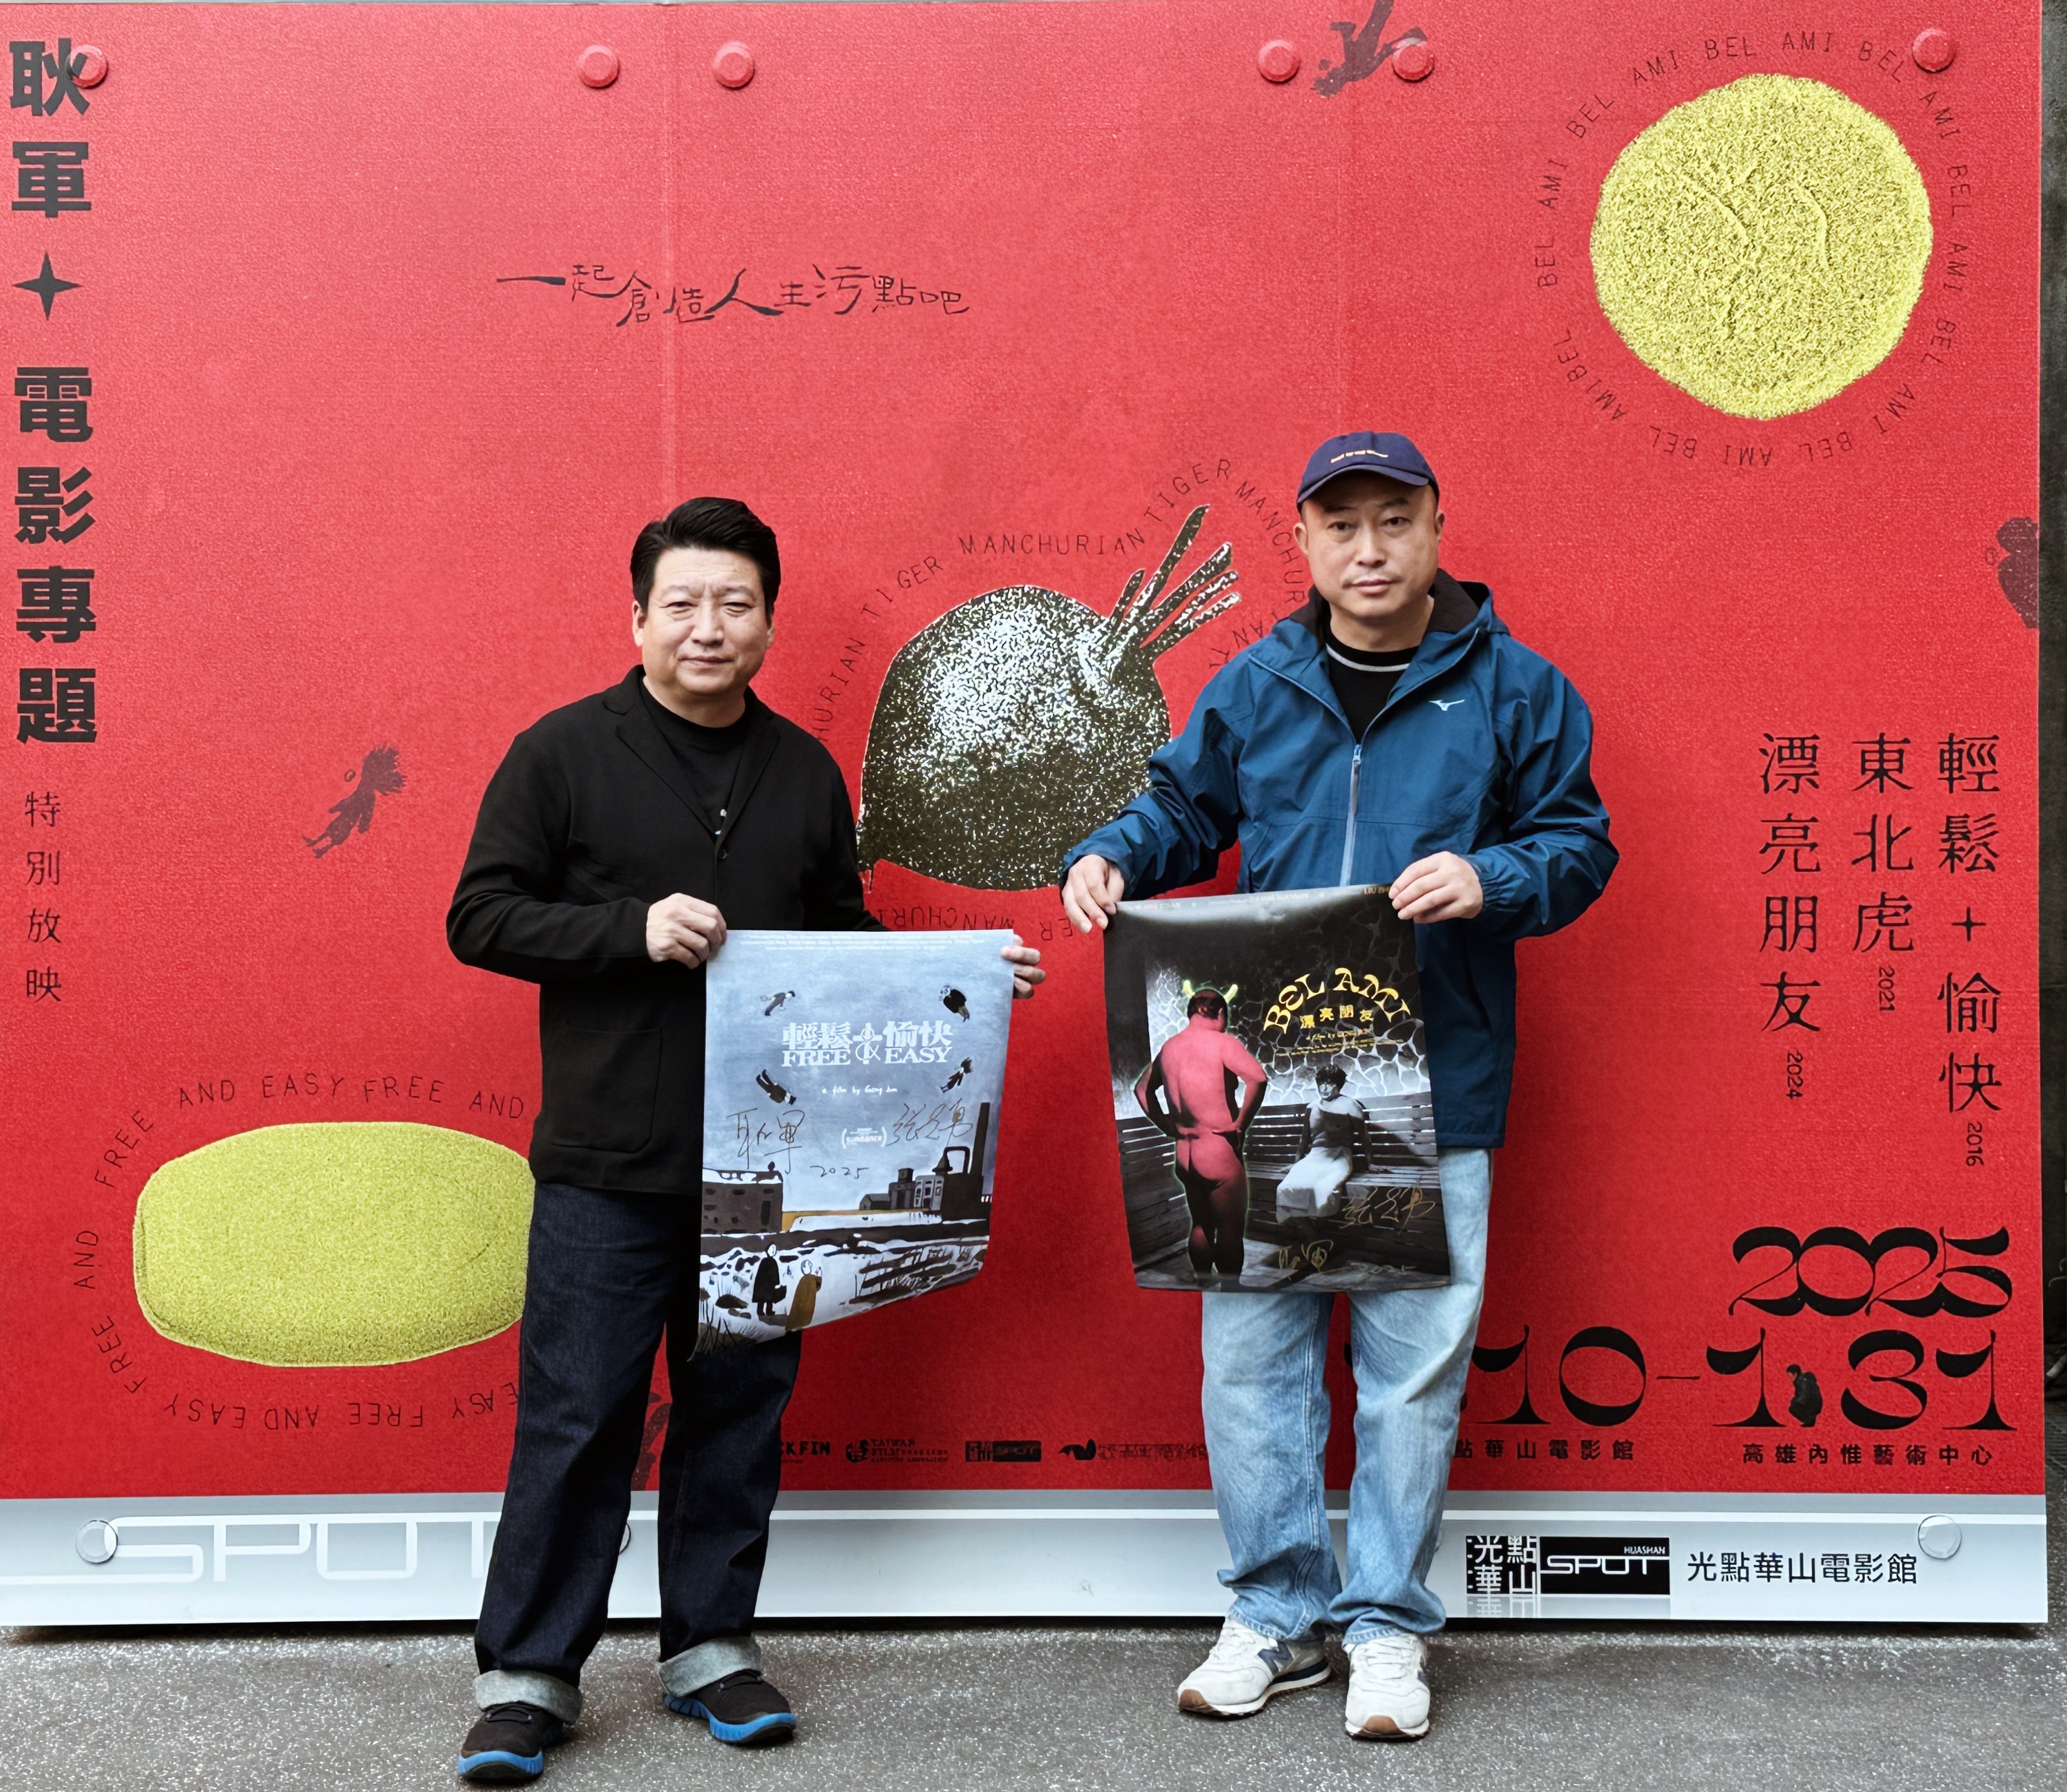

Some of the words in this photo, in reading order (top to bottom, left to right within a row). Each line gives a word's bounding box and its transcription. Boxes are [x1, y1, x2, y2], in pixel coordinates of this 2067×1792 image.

[1704, 36, 1756, 59] BEL
[1782, 31, 1833, 53] AMI
[1858, 41, 1905, 83] BEL
[1631, 50, 1679, 87] AMI
[1565, 95, 1615, 138] BEL
[1920, 90, 1960, 141] AMI
[1542, 159, 1568, 209] AMI
[1947, 164, 1971, 217] BEL
[1536, 237, 1559, 287] BEL
[1945, 242, 1968, 292] AMI
[1554, 328, 1588, 382] BEL
[1920, 317, 1956, 365] BEL
[1586, 377, 1628, 422] AMI
[1873, 383, 1916, 434] AMI
[1649, 425, 1697, 459] BEL
[1721, 444, 1774, 468] AMI
[1798, 431, 1853, 463] BEL
[14, 367, 97, 745] 電影專題
[859, 555, 943, 619] TIGER
[958, 526, 1146, 556] MANCHURIAN
[1143, 459, 1232, 524] TIGER
[1851, 732, 1914, 954] 東北虎
[24, 791, 62, 1003] 特別放映
[1758, 732, 1821, 1032] 漂亮朋友
[1263, 974, 1325, 1035] BEL
[1332, 967, 1412, 1023] AMI
[1878, 964, 1896, 1012] 2021
[781, 1049, 851, 1067] FREE
[883, 1046, 953, 1064] EASY
[1785, 1049, 1804, 1100] 2024
[94, 1110, 154, 1188] FREE
[179, 1079, 236, 1109] AND
[262, 1072, 345, 1099] EASY
[364, 1075, 445, 1103] FREE
[469, 1090, 524, 1120] AND
[1965, 1121, 1985, 1167] 2016
[810, 1165, 869, 1180] 2025
[73, 1229, 99, 1290] AND
[1728, 1226, 2013, 1319] 2025
[91, 1316, 147, 1393] FREE
[164, 1393, 246, 1430] EASY
[264, 1404, 319, 1430] AND
[349, 1402, 424, 1428] FREE
[452, 1382, 519, 1419] EASY
[1742, 1443, 1992, 1466] 高雄內惟藝術中心
[1541, 1555, 1670, 1575] SPOT
[1624, 1545, 1666, 1555] HUASHAN
[1688, 1551, 1919, 1586] 光點華山電影館
